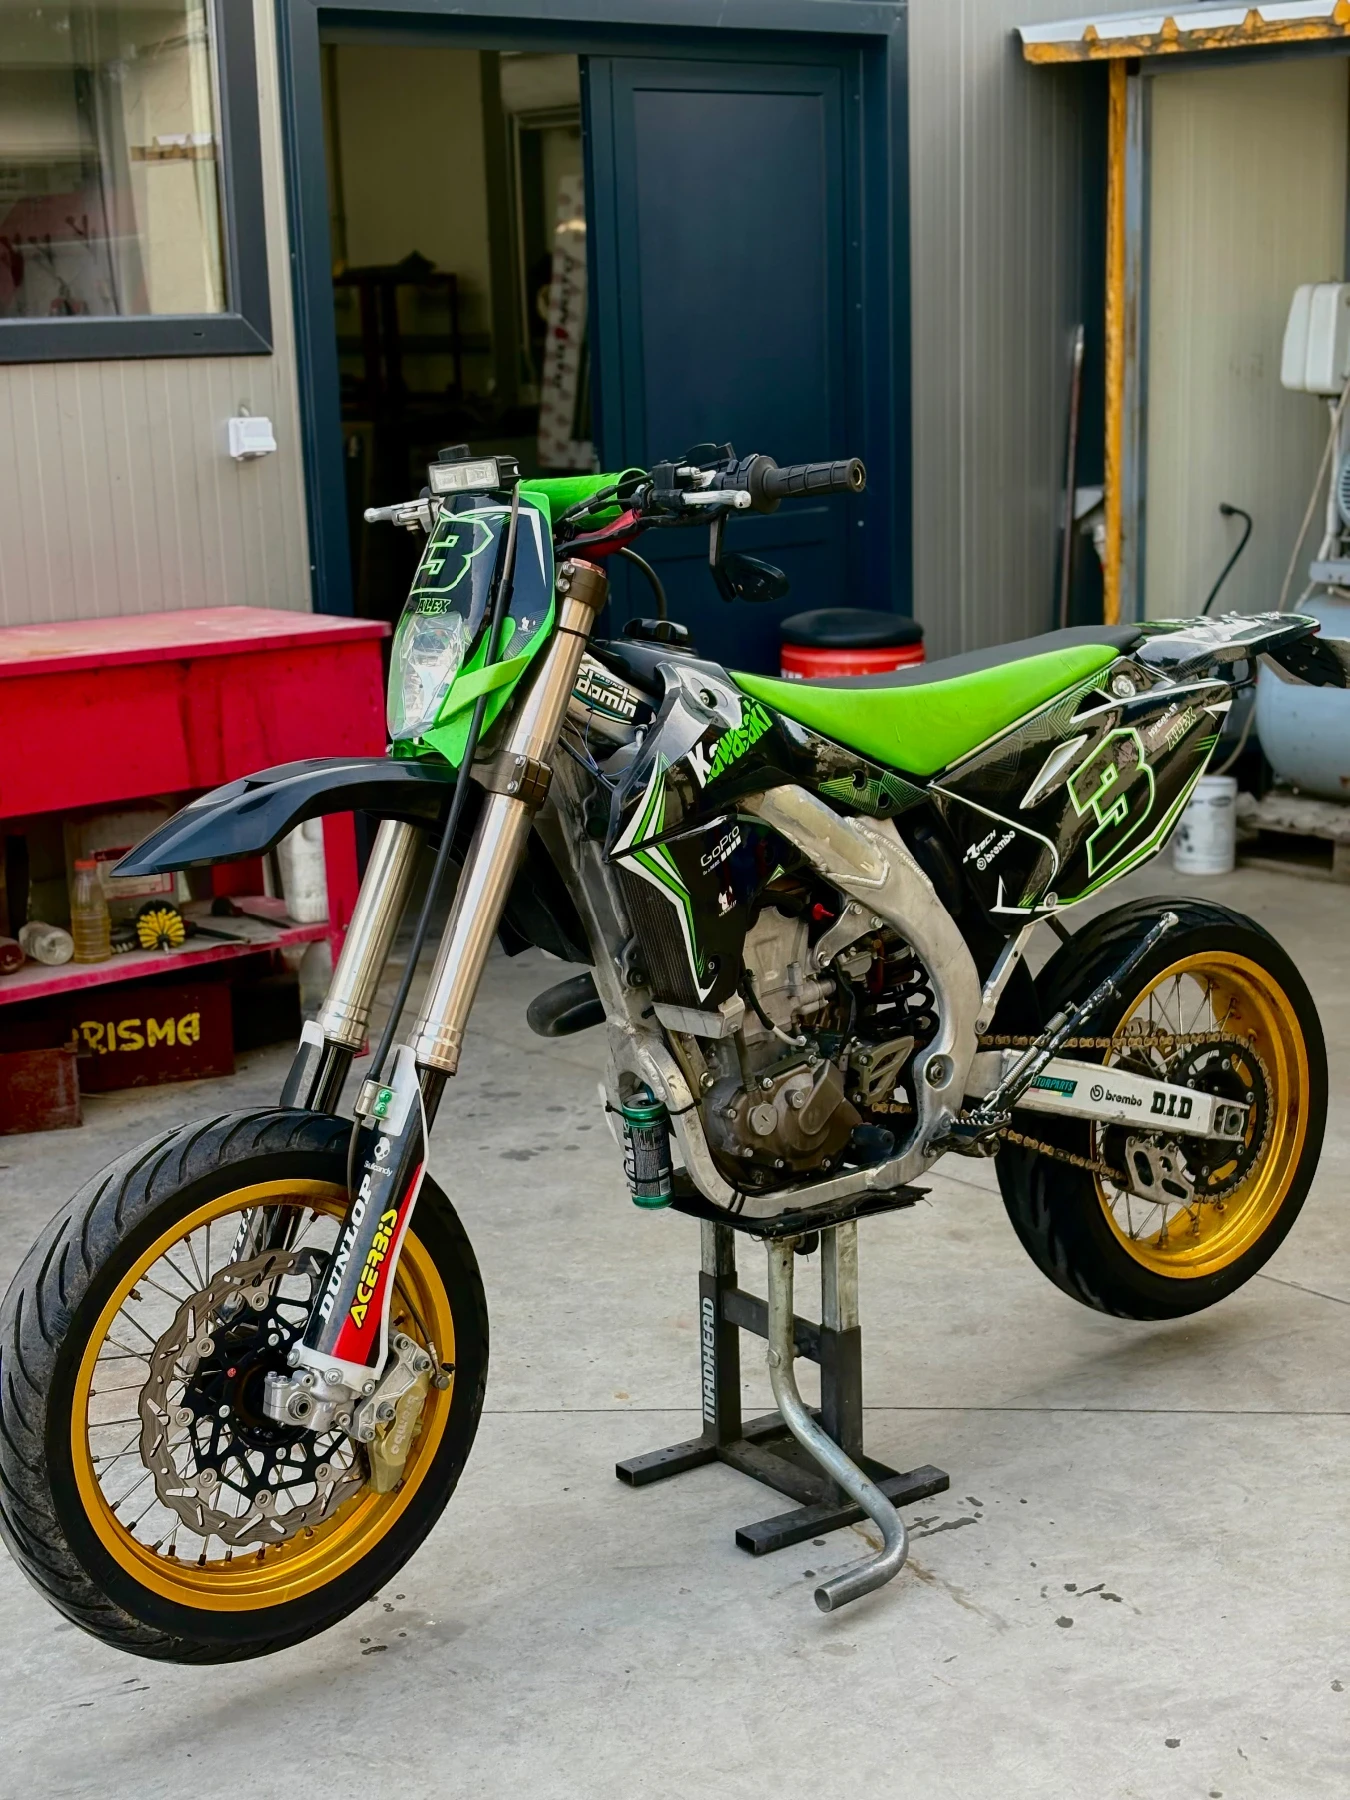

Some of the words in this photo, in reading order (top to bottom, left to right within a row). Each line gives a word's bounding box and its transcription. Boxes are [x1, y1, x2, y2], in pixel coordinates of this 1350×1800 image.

[416, 598, 452, 614] ALEX
[686, 699, 773, 789] Kawasaki
[1165, 705, 1197, 751] ALEX
[700, 825, 740, 867] GoPro
[983, 830, 1016, 863] brembo
[1105, 1090, 1142, 1107] brembo
[1150, 1091, 1193, 1120] D.I.D
[319, 1173, 371, 1325] DUNLOP
[703, 1297, 716, 1425] MADHEAD
